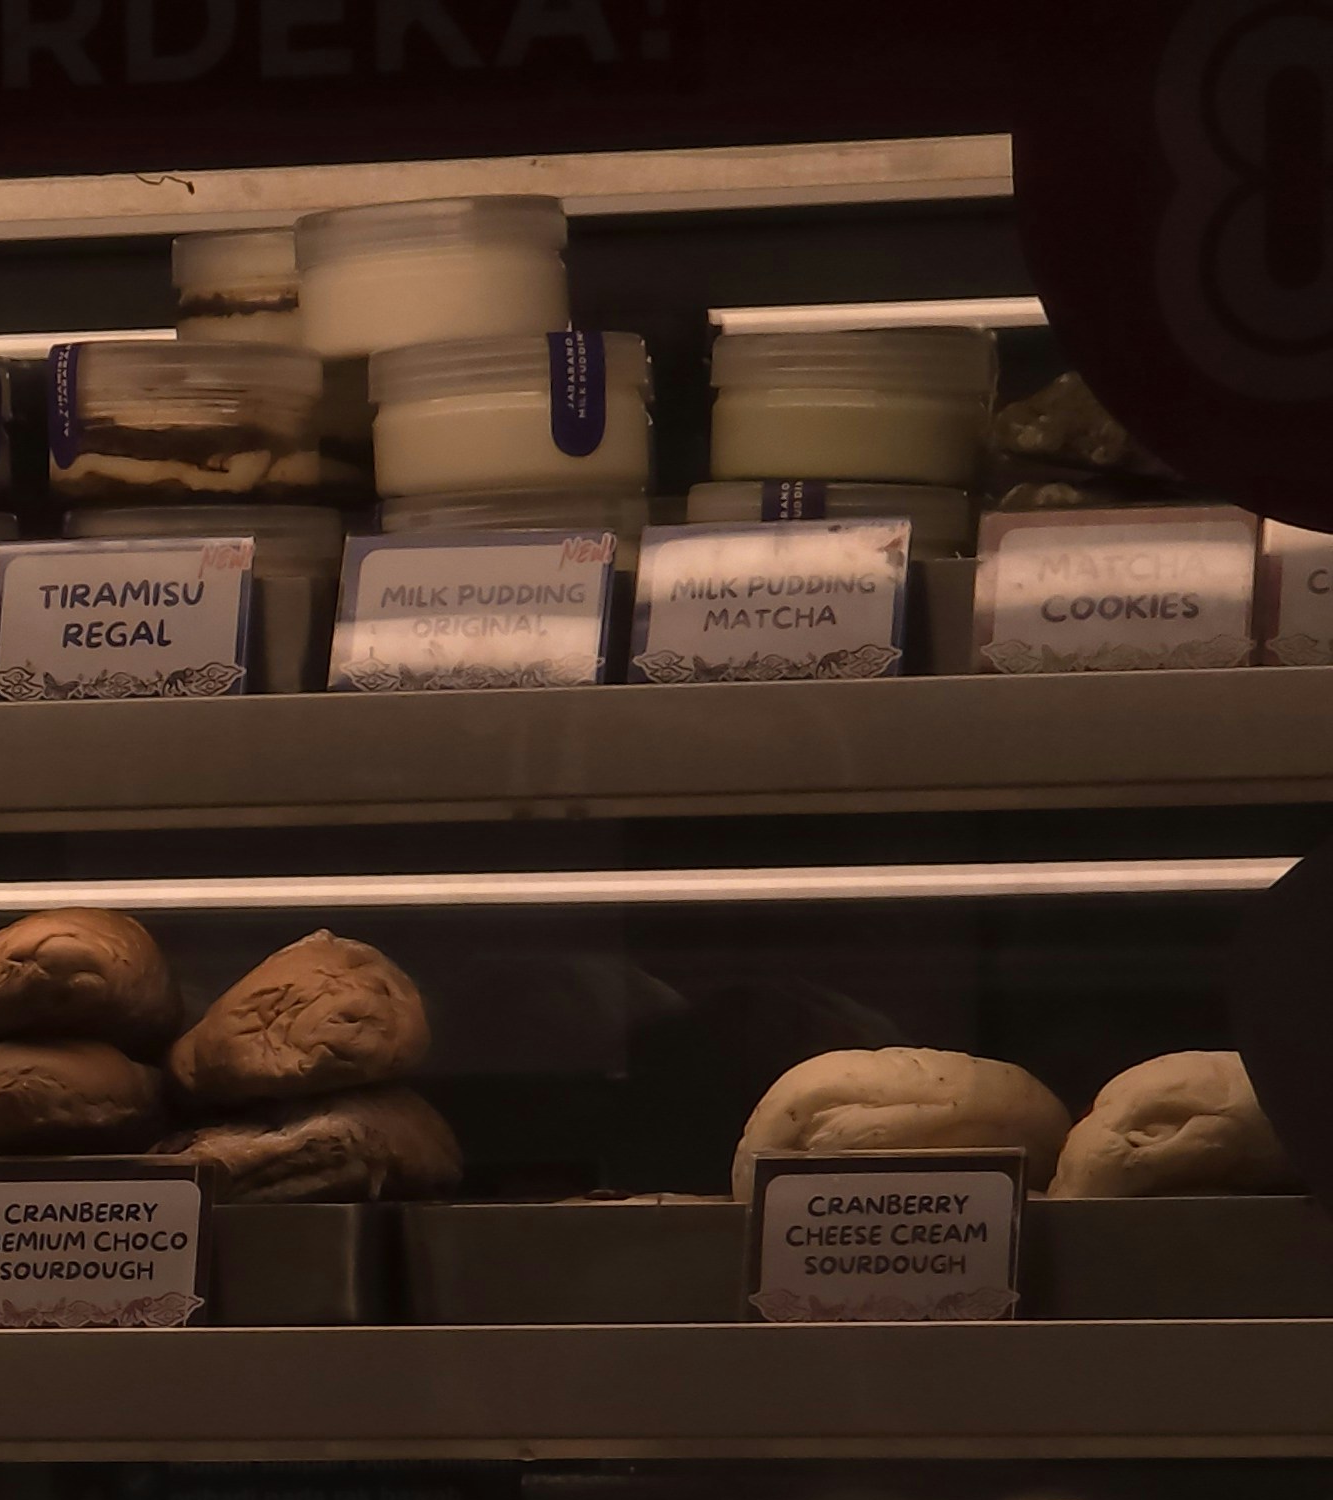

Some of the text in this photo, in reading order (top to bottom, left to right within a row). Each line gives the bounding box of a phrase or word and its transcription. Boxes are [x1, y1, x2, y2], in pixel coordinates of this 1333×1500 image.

[39, 580, 204, 609] TIRAMISU
[381, 582, 586, 608] MILK PUDDING
[670, 573, 876, 602] MILK PUDDING
[703, 605, 836, 631] MATCHA
[1041, 593, 1199, 622] COOKIES
[62, 619, 172, 649] REGAL
[412, 615, 548, 639] ORIGINAL
[5, 1202, 158, 1224] CRANBERRY
[807, 1195, 969, 1217] CRANBERRY
[94, 1231, 188, 1251] CHOCO
[786, 1221, 987, 1247] CHEESE CREAM
[0, 1261, 154, 1281] SOURDOUGH
[804, 1255, 966, 1275] SOURDOUGH
